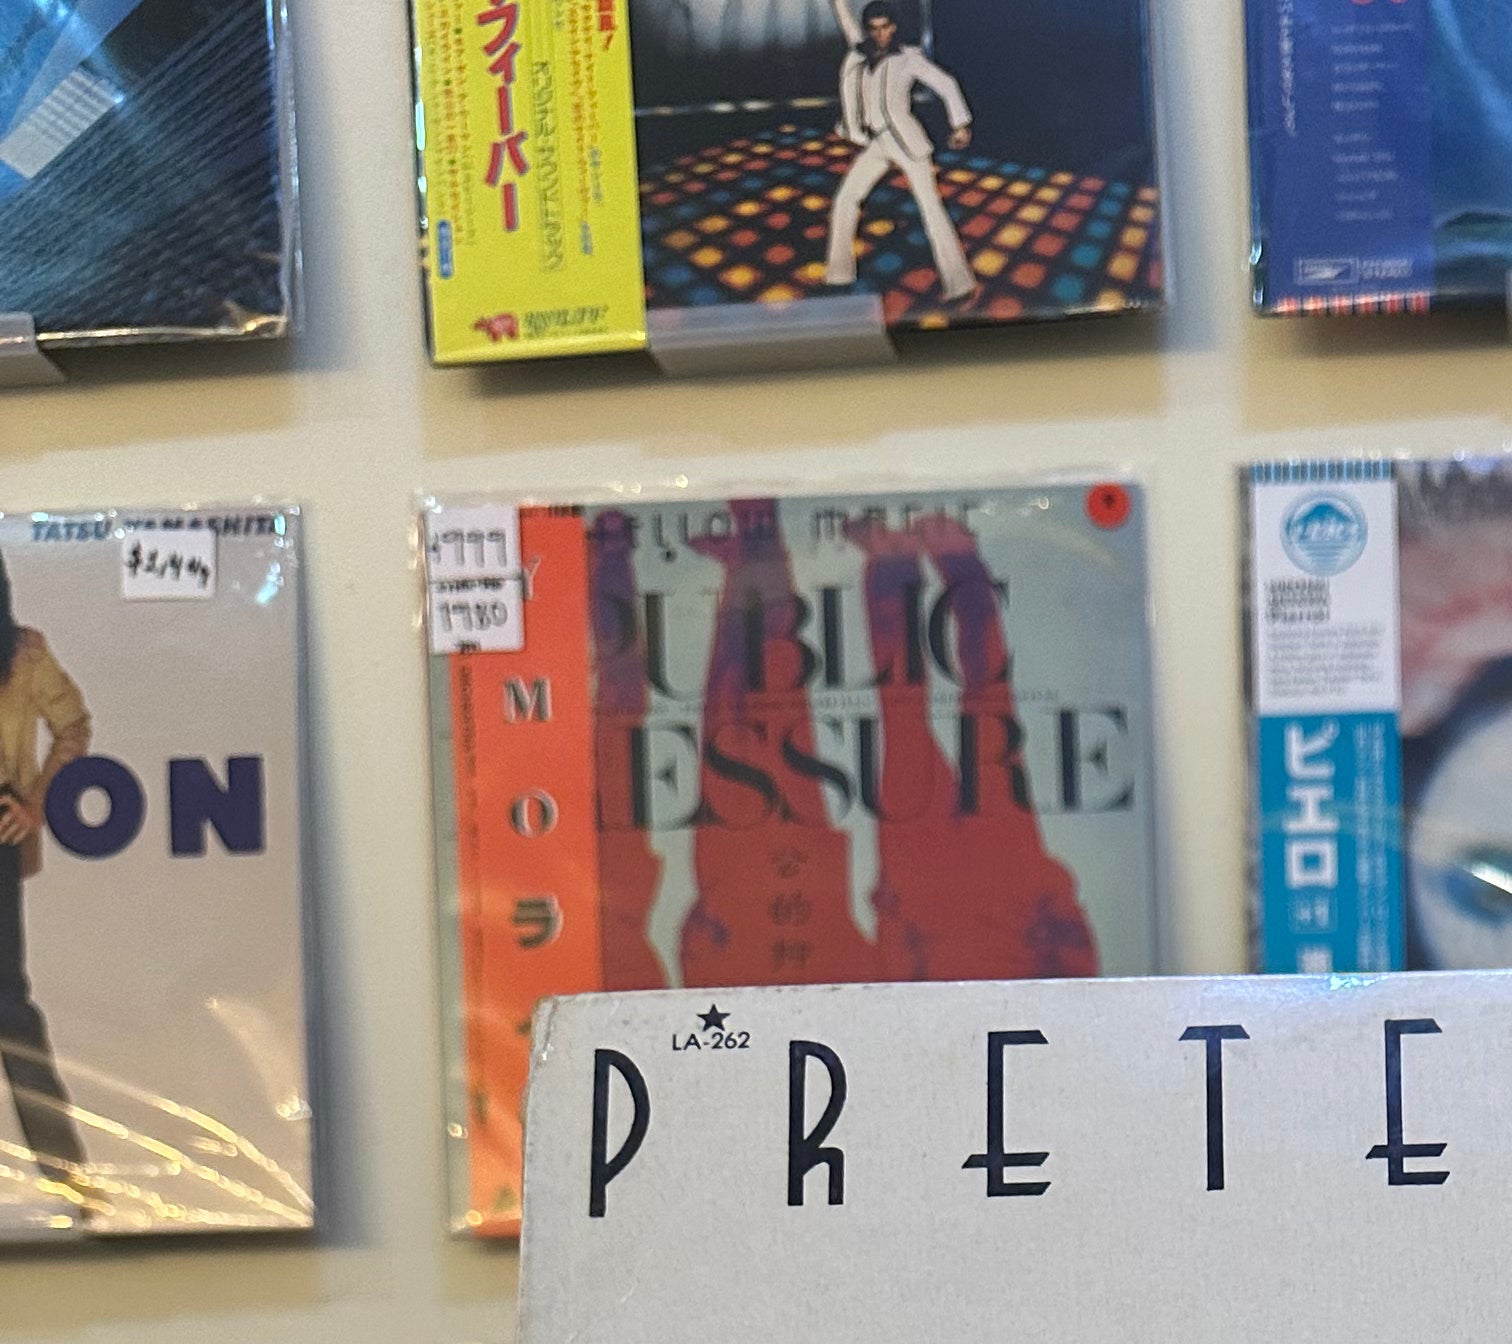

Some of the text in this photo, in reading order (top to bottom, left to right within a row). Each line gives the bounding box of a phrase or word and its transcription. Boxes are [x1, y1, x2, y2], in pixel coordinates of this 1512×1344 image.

[44, 753, 267, 861] ON
[604, 705, 1136, 834] ESSURE
[672, 1031, 751, 1051] LA-262
